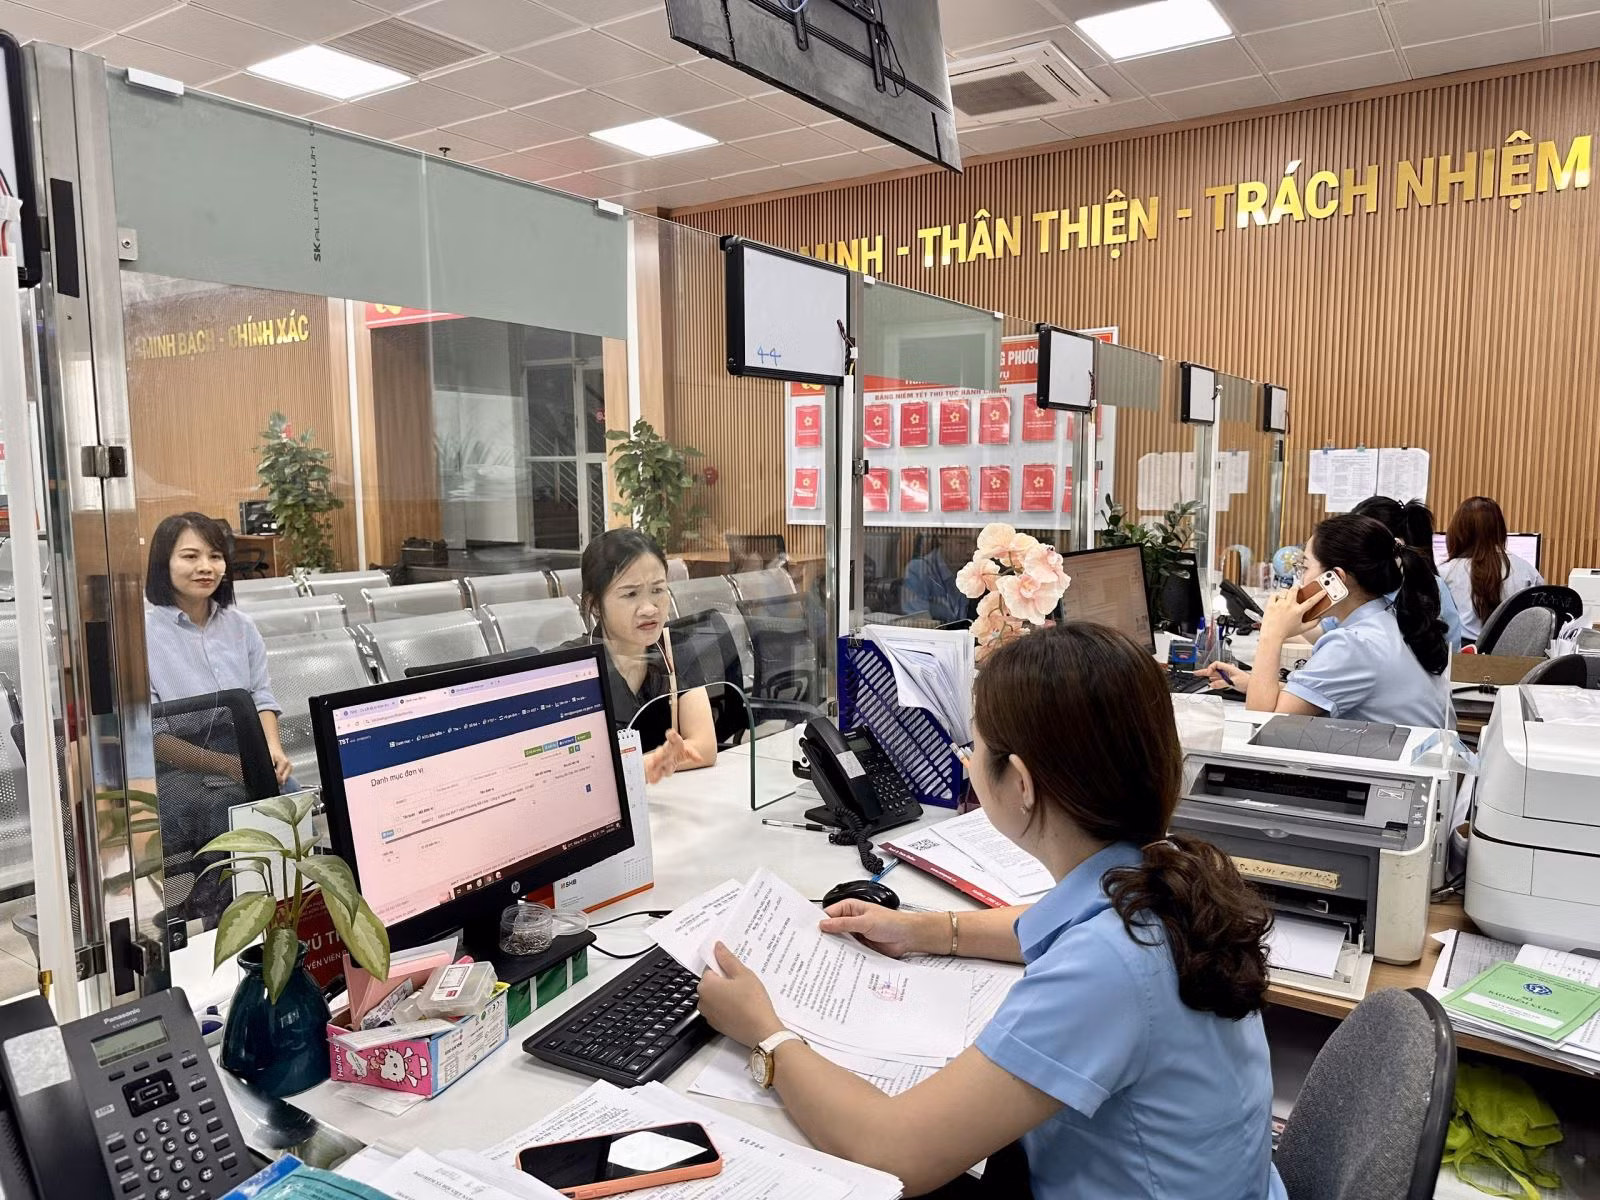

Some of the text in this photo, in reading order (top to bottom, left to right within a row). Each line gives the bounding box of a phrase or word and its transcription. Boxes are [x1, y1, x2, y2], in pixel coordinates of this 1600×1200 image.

[917, 208, 1022, 268] THÂN
[1032, 188, 1159, 259] THIỆN
[1205, 159, 1379, 231] TRÁCH
[1397, 129, 1591, 211] NHIỆM
[178, 327, 215, 361] BẠCH
[228, 315, 274, 349] CHÍNH
[275, 308, 309, 344] XÁC
[757, 345, 782, 366] 44
[323, 952, 342, 965] VIÊN
[103, 1007, 141, 1025] Panasonic
[140, 1112, 190, 1140] 1 2 3
[145, 1131, 197, 1159] 4 5 6
[153, 1150, 204, 1179] 7 8 9
[182, 1180, 190, 1189] 0
